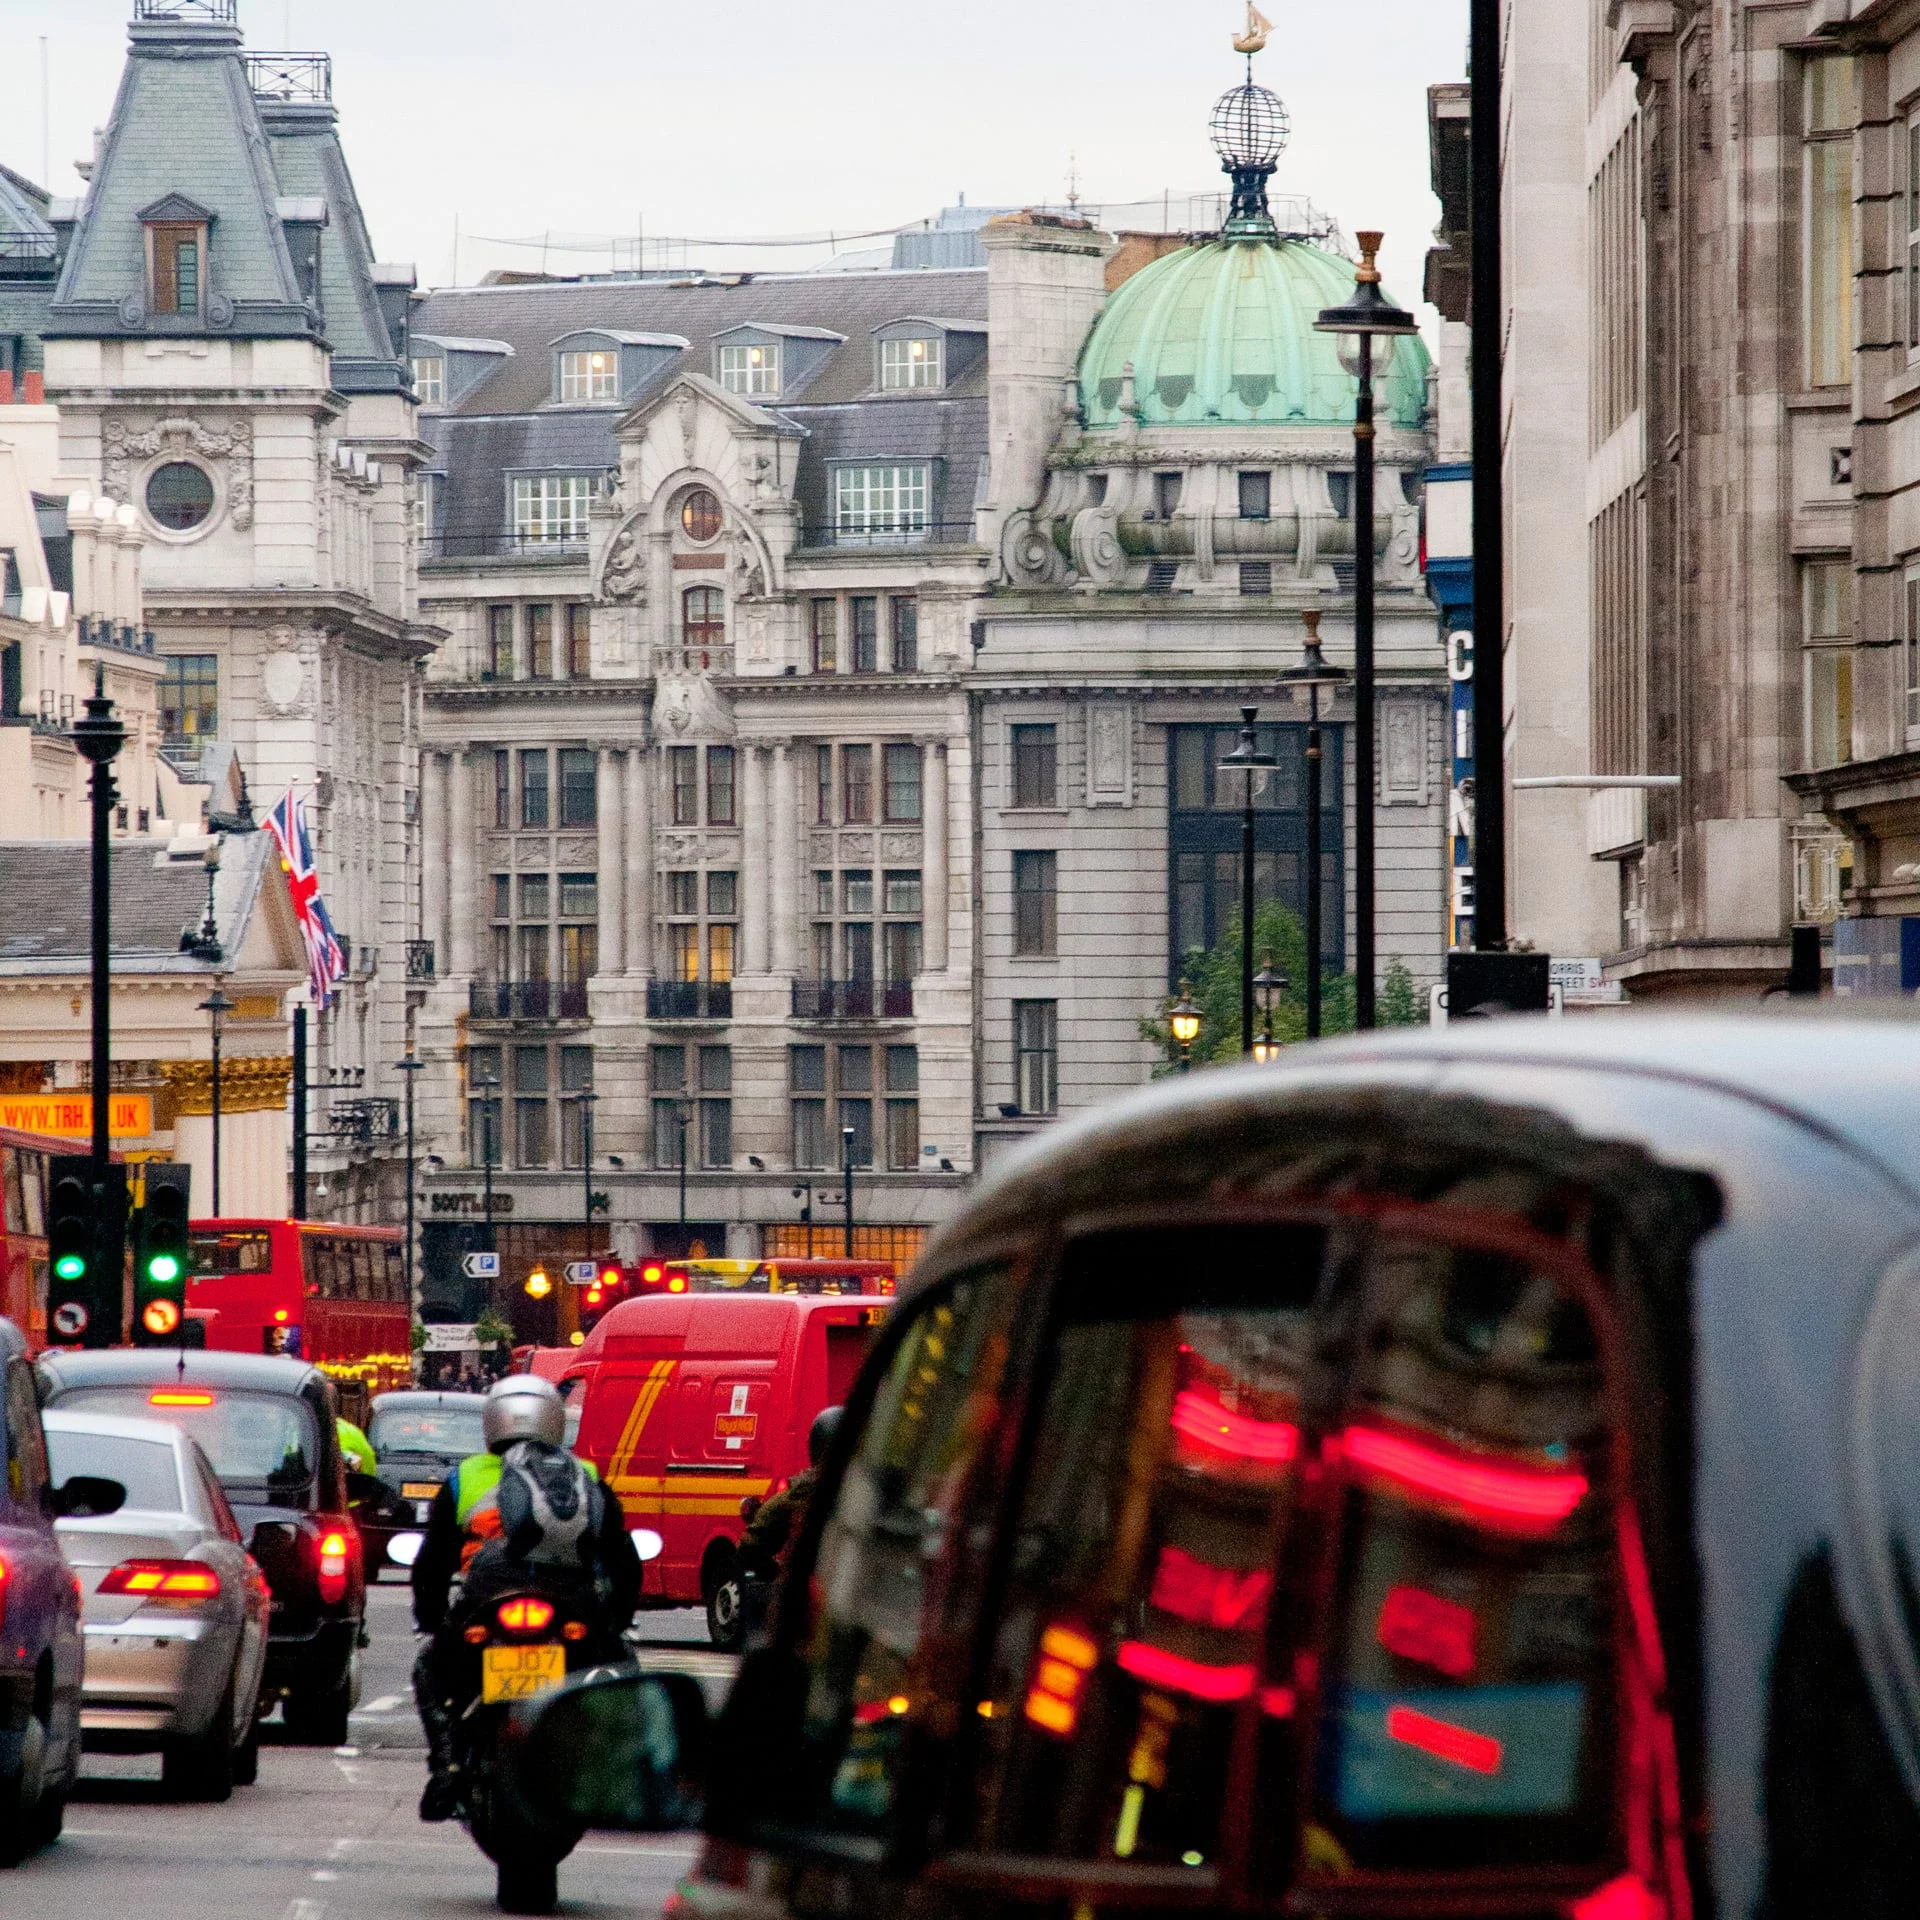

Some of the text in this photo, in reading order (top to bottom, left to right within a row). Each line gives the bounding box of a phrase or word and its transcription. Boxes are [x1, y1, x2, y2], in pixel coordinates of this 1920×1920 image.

[1447, 630, 1475, 950] CINE
[1551, 963, 1585, 975] ORRIS
[1551, 977, 1586, 989] REET
[4, 1104, 137, 1128] WWW.TRH..UK
